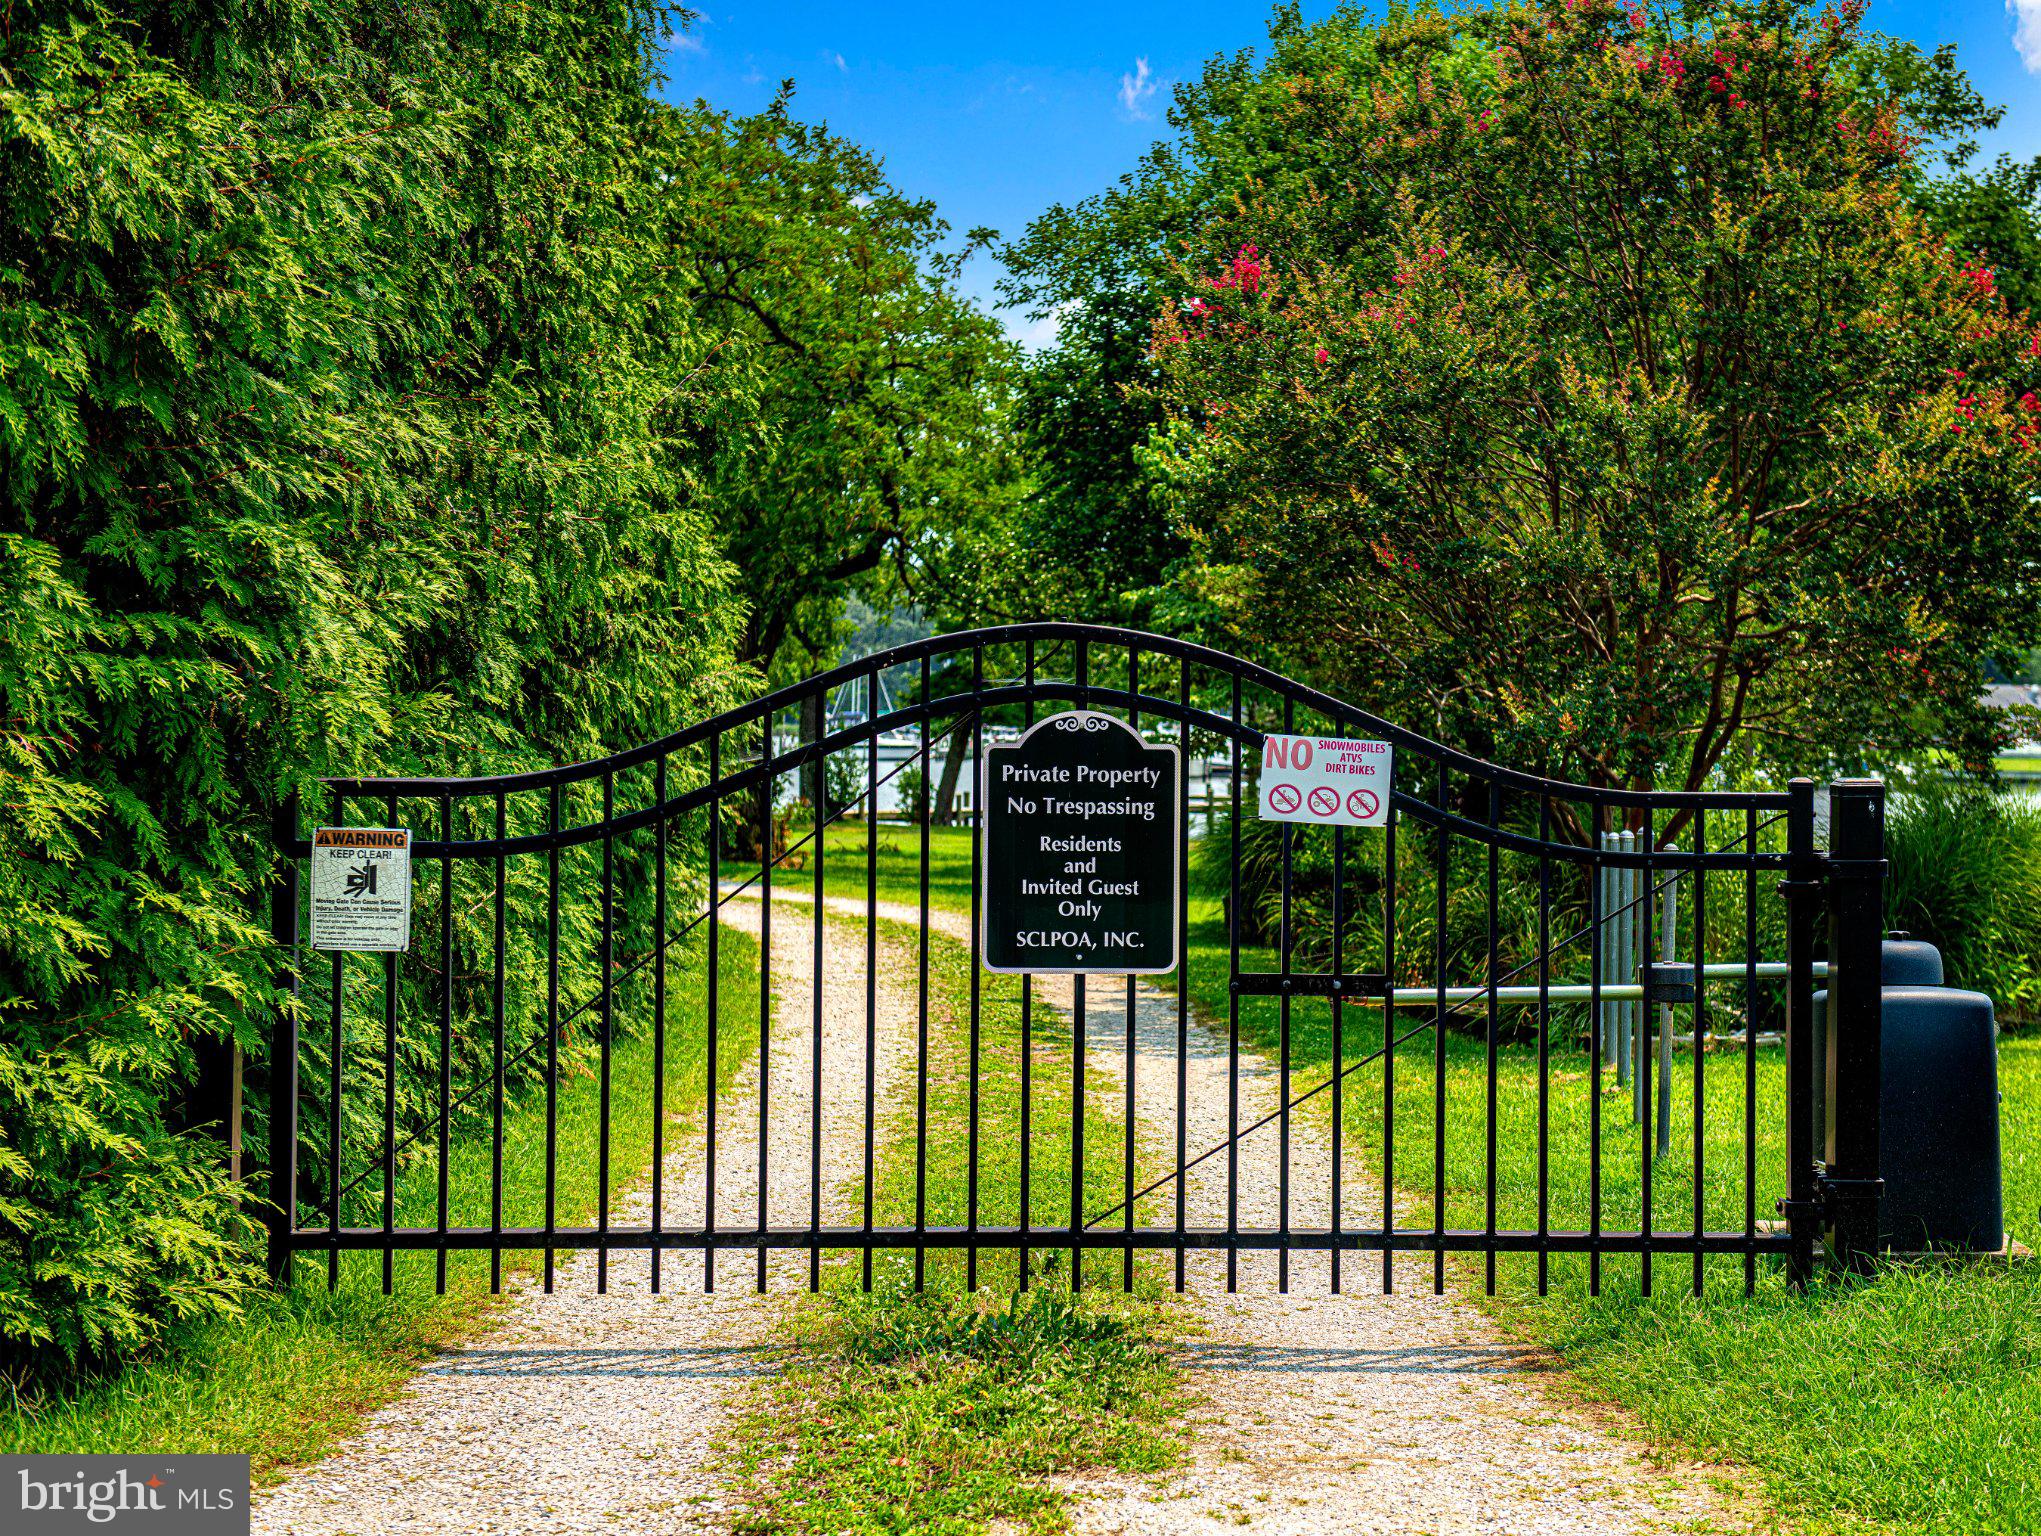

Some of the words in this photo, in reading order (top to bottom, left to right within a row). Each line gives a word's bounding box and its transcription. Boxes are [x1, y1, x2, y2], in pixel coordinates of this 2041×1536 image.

[1265, 737, 1313, 771] NO
[1318, 740, 1386, 753] SNOWMOBILES
[1002, 764, 1070, 782] Private
[1077, 765, 1161, 788] Property
[1325, 763, 1347, 774] DIRT
[1349, 765, 1375, 775] BIKES
[1007, 797, 1036, 814] No
[1043, 796, 1155, 821] Trespassing
[332, 832, 405, 847] WARNING
[1040, 835, 1122, 852] Residents
[330, 849, 355, 859] KEEP
[357, 850, 392, 859] CLEAR!
[1063, 857, 1096, 874] and
[1022, 878, 1082, 895] Invited
[1088, 879, 1139, 896] Guest
[1058, 900, 1102, 921] Only
[1016, 931, 1097, 950] SCLPOA,
[1103, 932, 1145, 948] INC.
